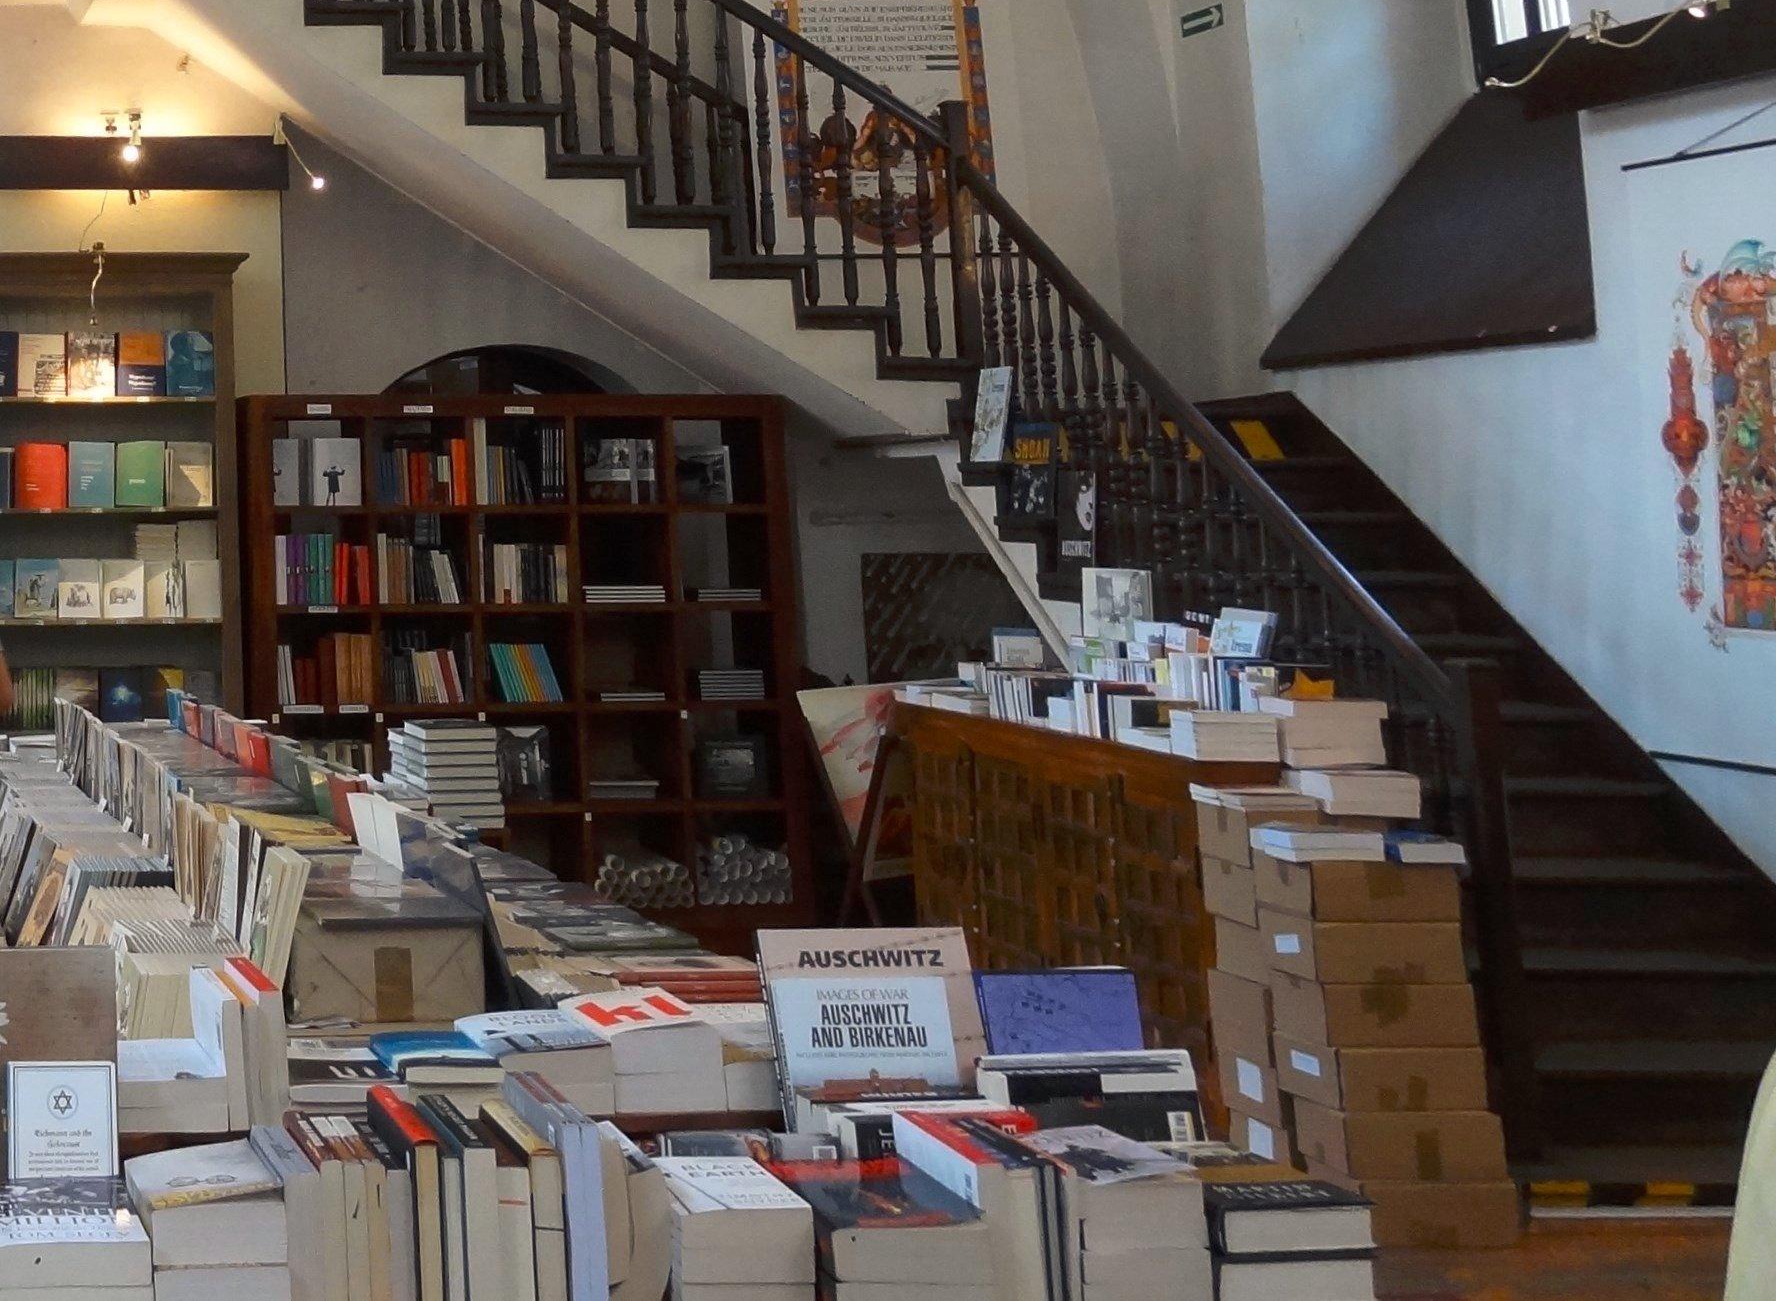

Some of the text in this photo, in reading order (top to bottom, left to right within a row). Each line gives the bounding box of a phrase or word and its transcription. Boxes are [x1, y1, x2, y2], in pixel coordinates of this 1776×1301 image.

[798, 949, 944, 968] AUSCHWITZ
[816, 988, 910, 1000] IMAGES OF WAR
[820, 1003, 911, 1026] AUSCHWITZ
[811, 1025, 928, 1049] AND BIRKENAU
